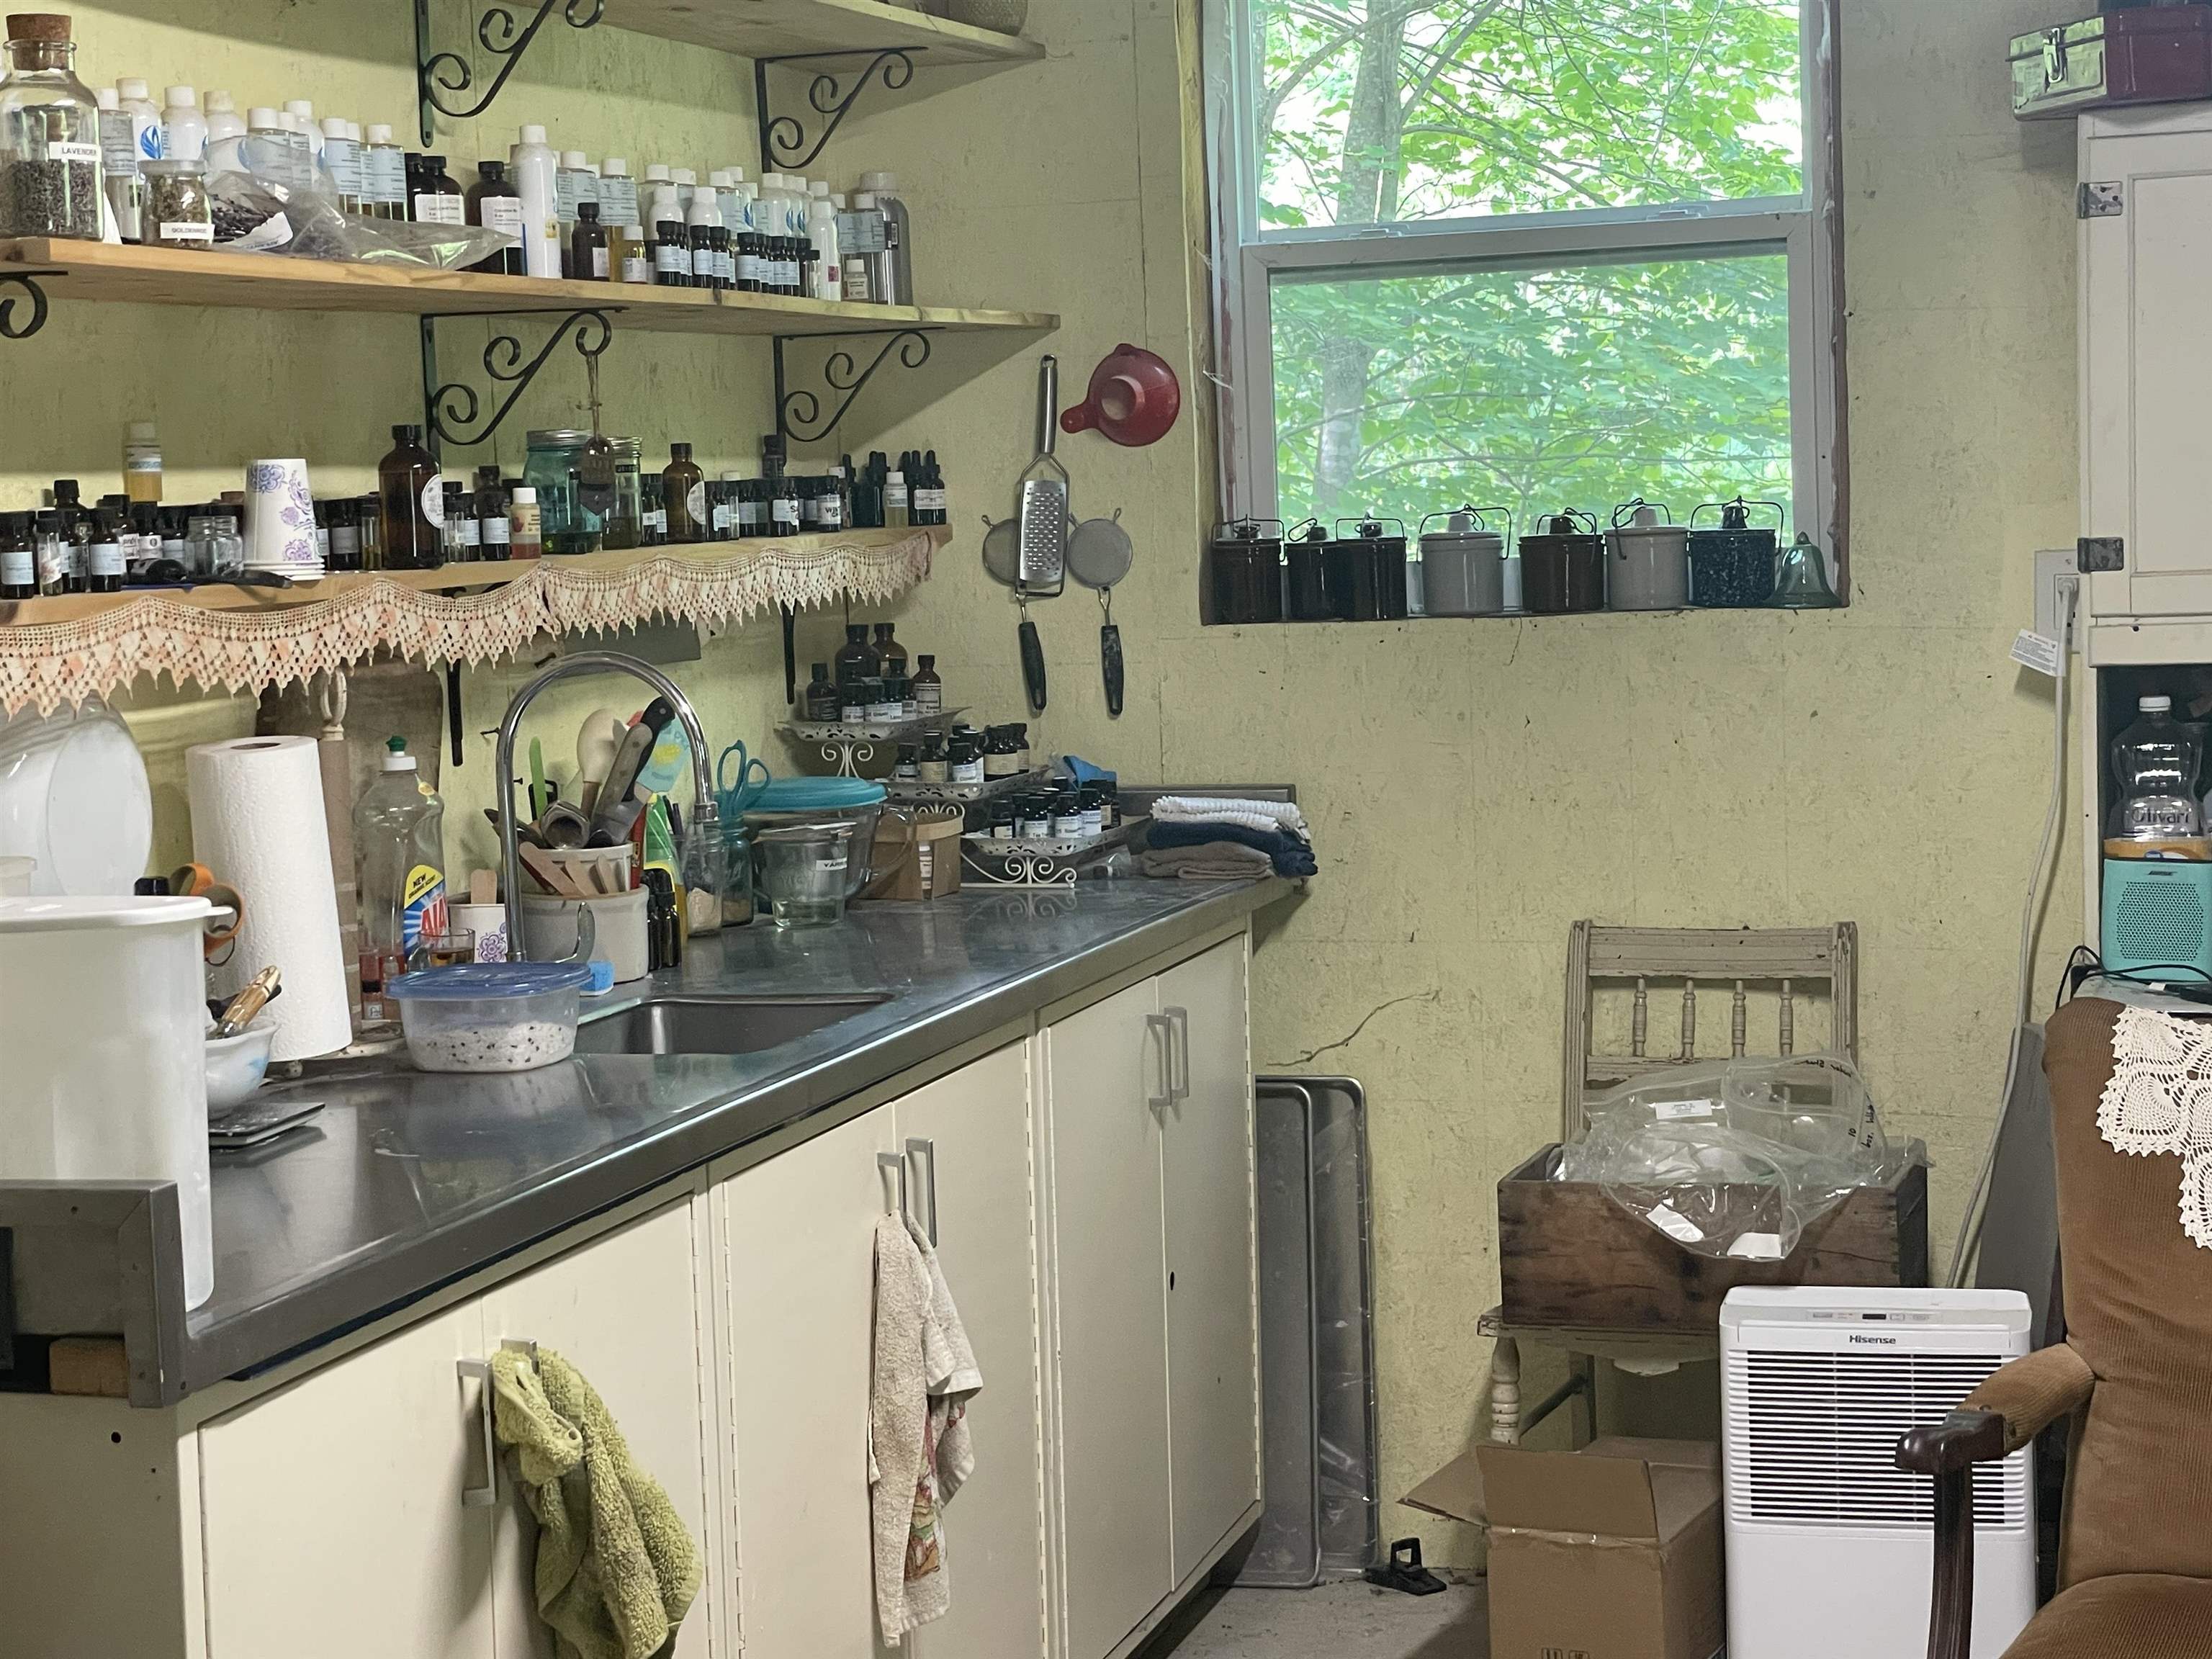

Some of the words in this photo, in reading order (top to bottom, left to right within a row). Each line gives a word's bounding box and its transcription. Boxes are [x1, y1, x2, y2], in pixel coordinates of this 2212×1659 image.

[2132, 807, 2189, 823] Olivari
[413, 873, 426, 889] NEW
[1849, 1335, 1897, 1344] Hisense
